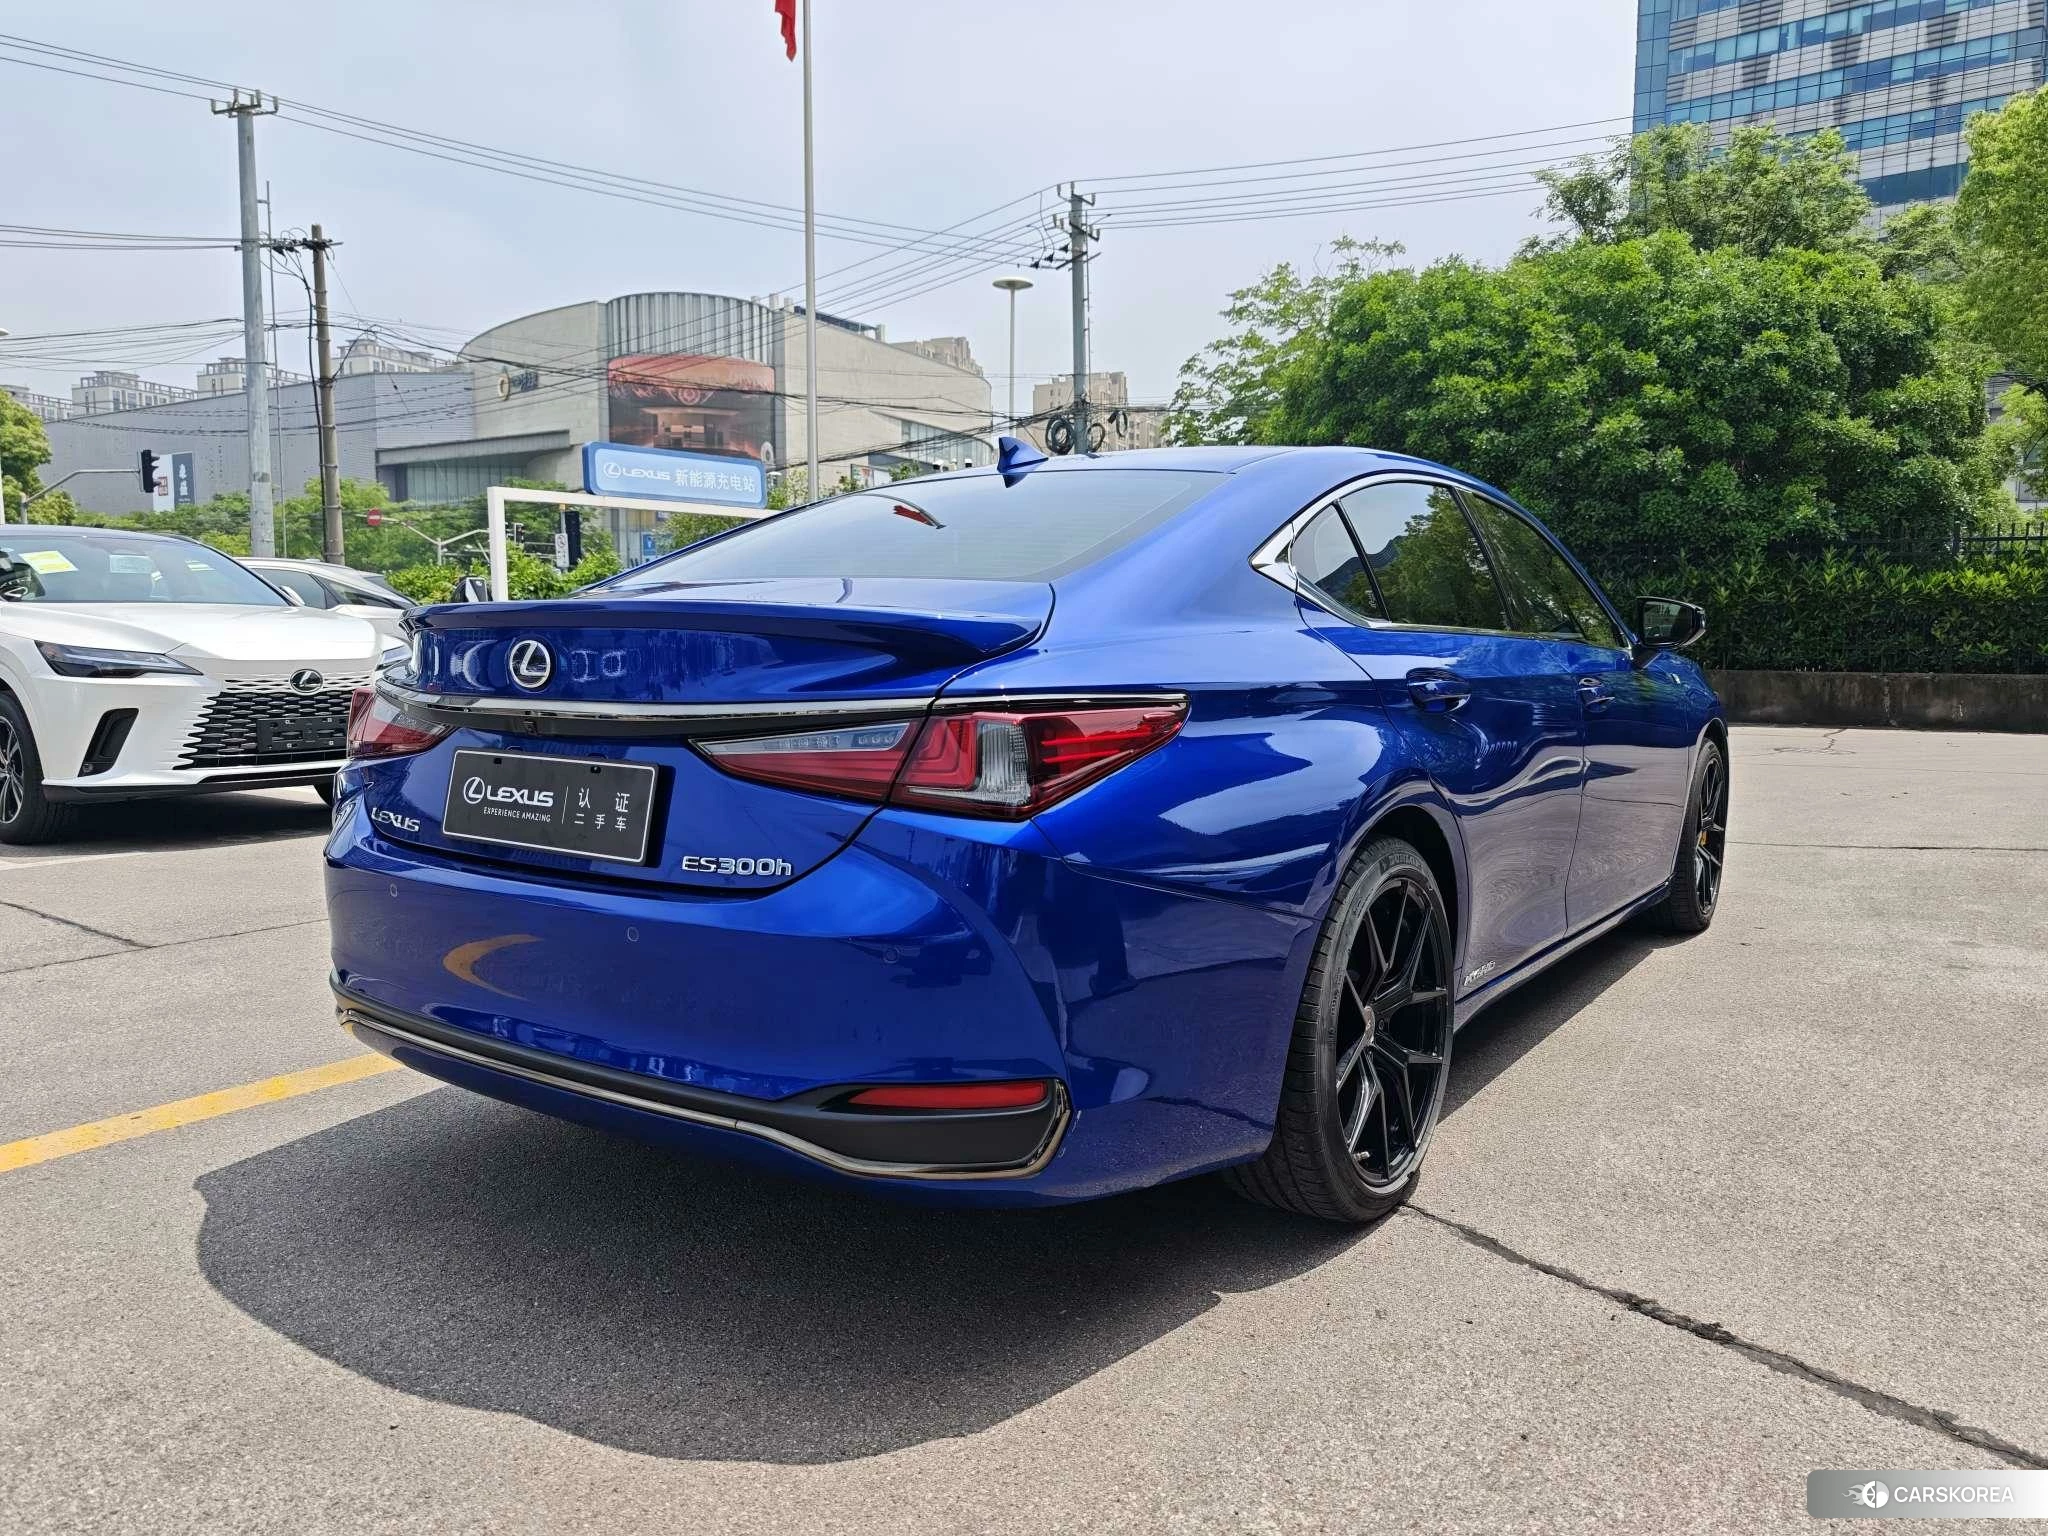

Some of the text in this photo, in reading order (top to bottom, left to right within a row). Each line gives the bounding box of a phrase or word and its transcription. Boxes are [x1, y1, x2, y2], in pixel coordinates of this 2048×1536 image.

[622, 468, 756, 493] LEXUS 新能源充电站
[486, 787, 554, 807] LEXUS
[371, 807, 420, 832] LEXUS
[483, 806, 551, 823] EXPERIENCE AMAZING
[574, 812, 627, 832] 二手车
[682, 856, 793, 877] ES300h
